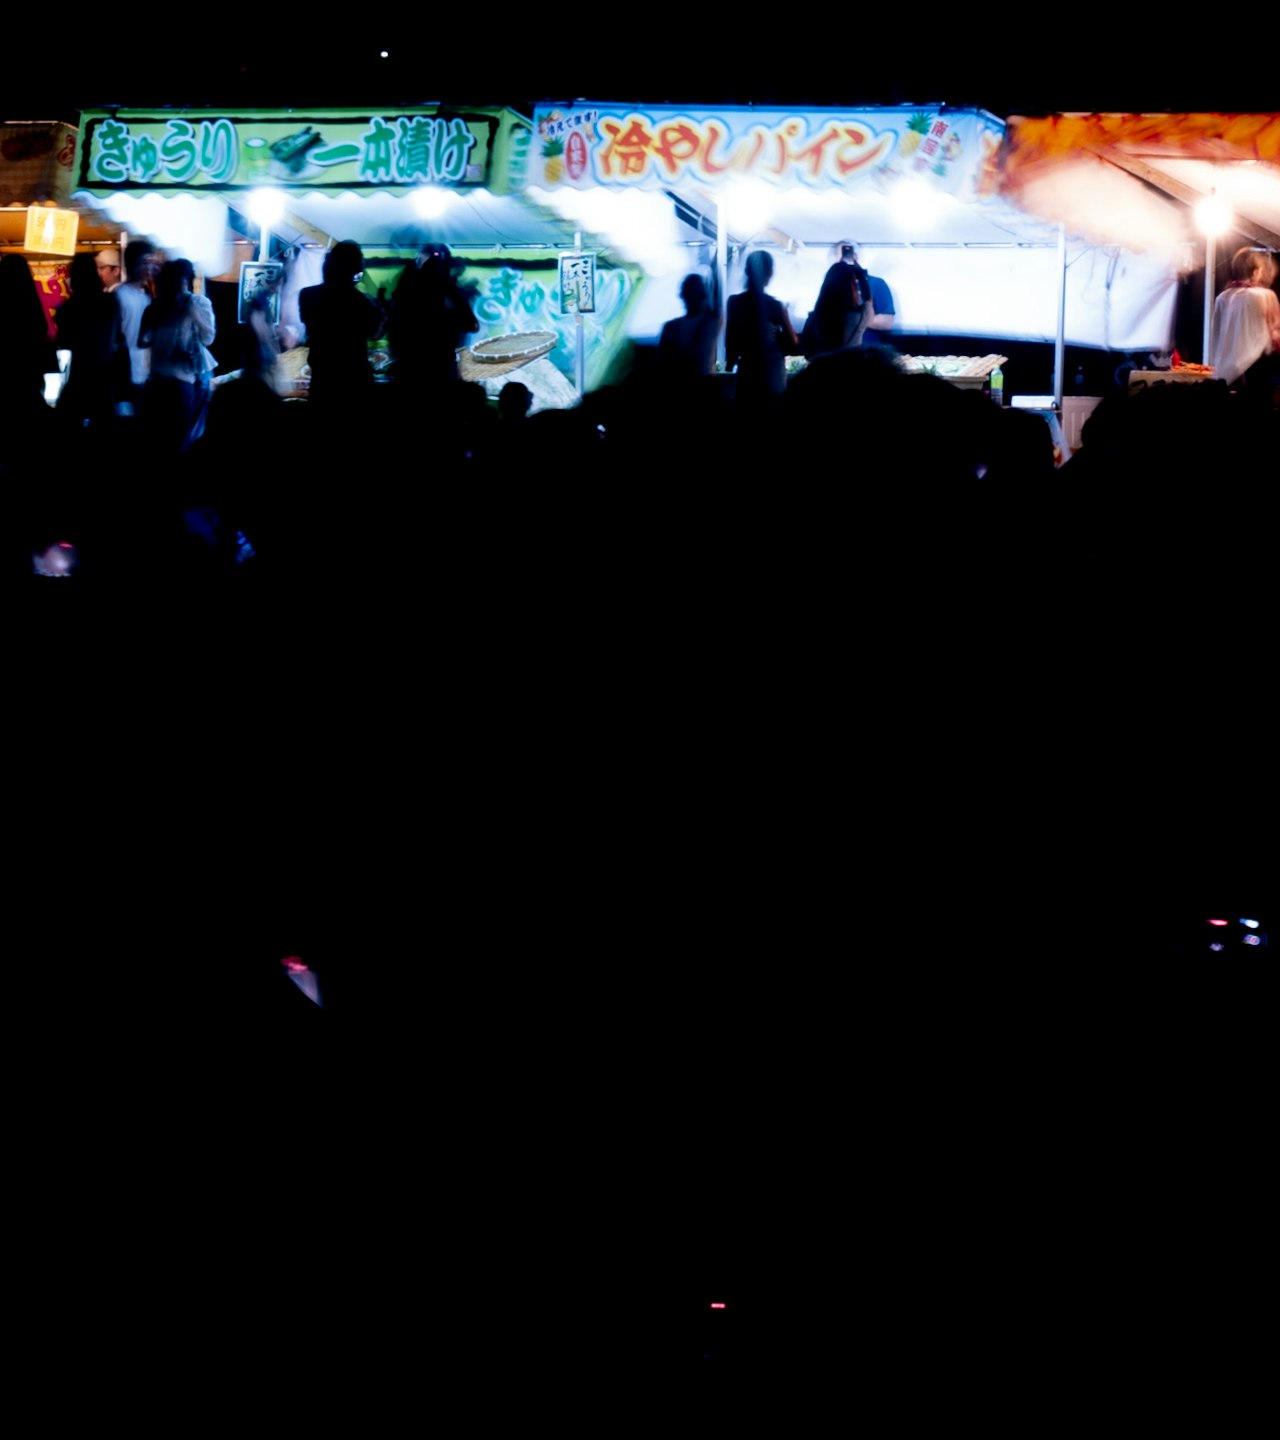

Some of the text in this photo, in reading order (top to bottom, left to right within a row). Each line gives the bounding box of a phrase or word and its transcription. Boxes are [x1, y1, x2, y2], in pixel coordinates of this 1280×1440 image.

[96, 119, 238, 183] きゅうり
[305, 116, 475, 183] 一本漬け
[598, 117, 892, 178] 冷やしパイン
